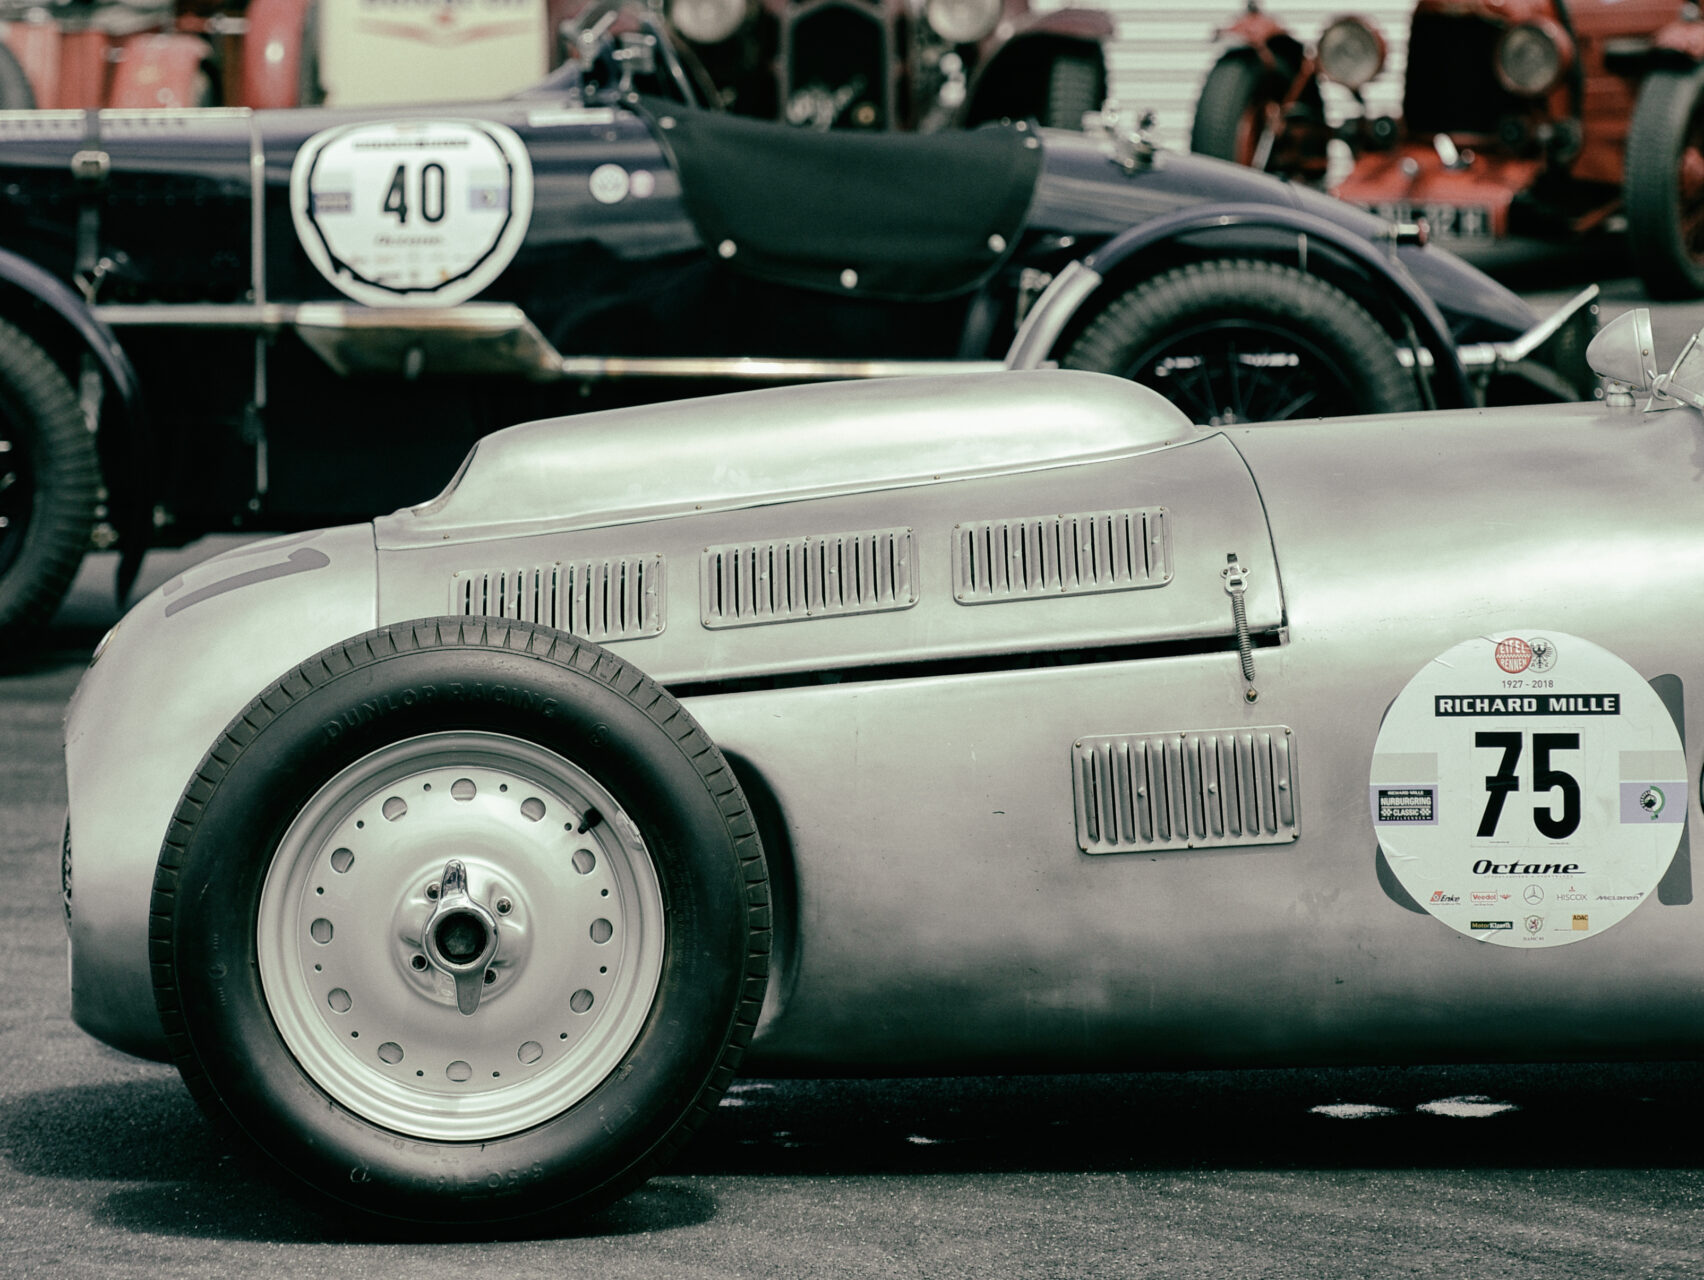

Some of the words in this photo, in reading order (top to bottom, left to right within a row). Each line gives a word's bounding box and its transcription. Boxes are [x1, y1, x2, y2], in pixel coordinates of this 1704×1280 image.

[383, 162, 445, 224] 40
[1502, 679, 1524, 689] 1927
[1531, 679, 1554, 689] 2018
[321, 684, 439, 744] DUNLOP
[448, 682, 560, 718] RACING
[1439, 698, 1537, 713] RICHARD
[1549, 697, 1616, 712] MILLE
[1475, 731, 1581, 840] 75
[1392, 809, 1420, 817] CLASSIC
[1472, 859, 1587, 875] Octane
[1556, 893, 1588, 901] HISCOX
